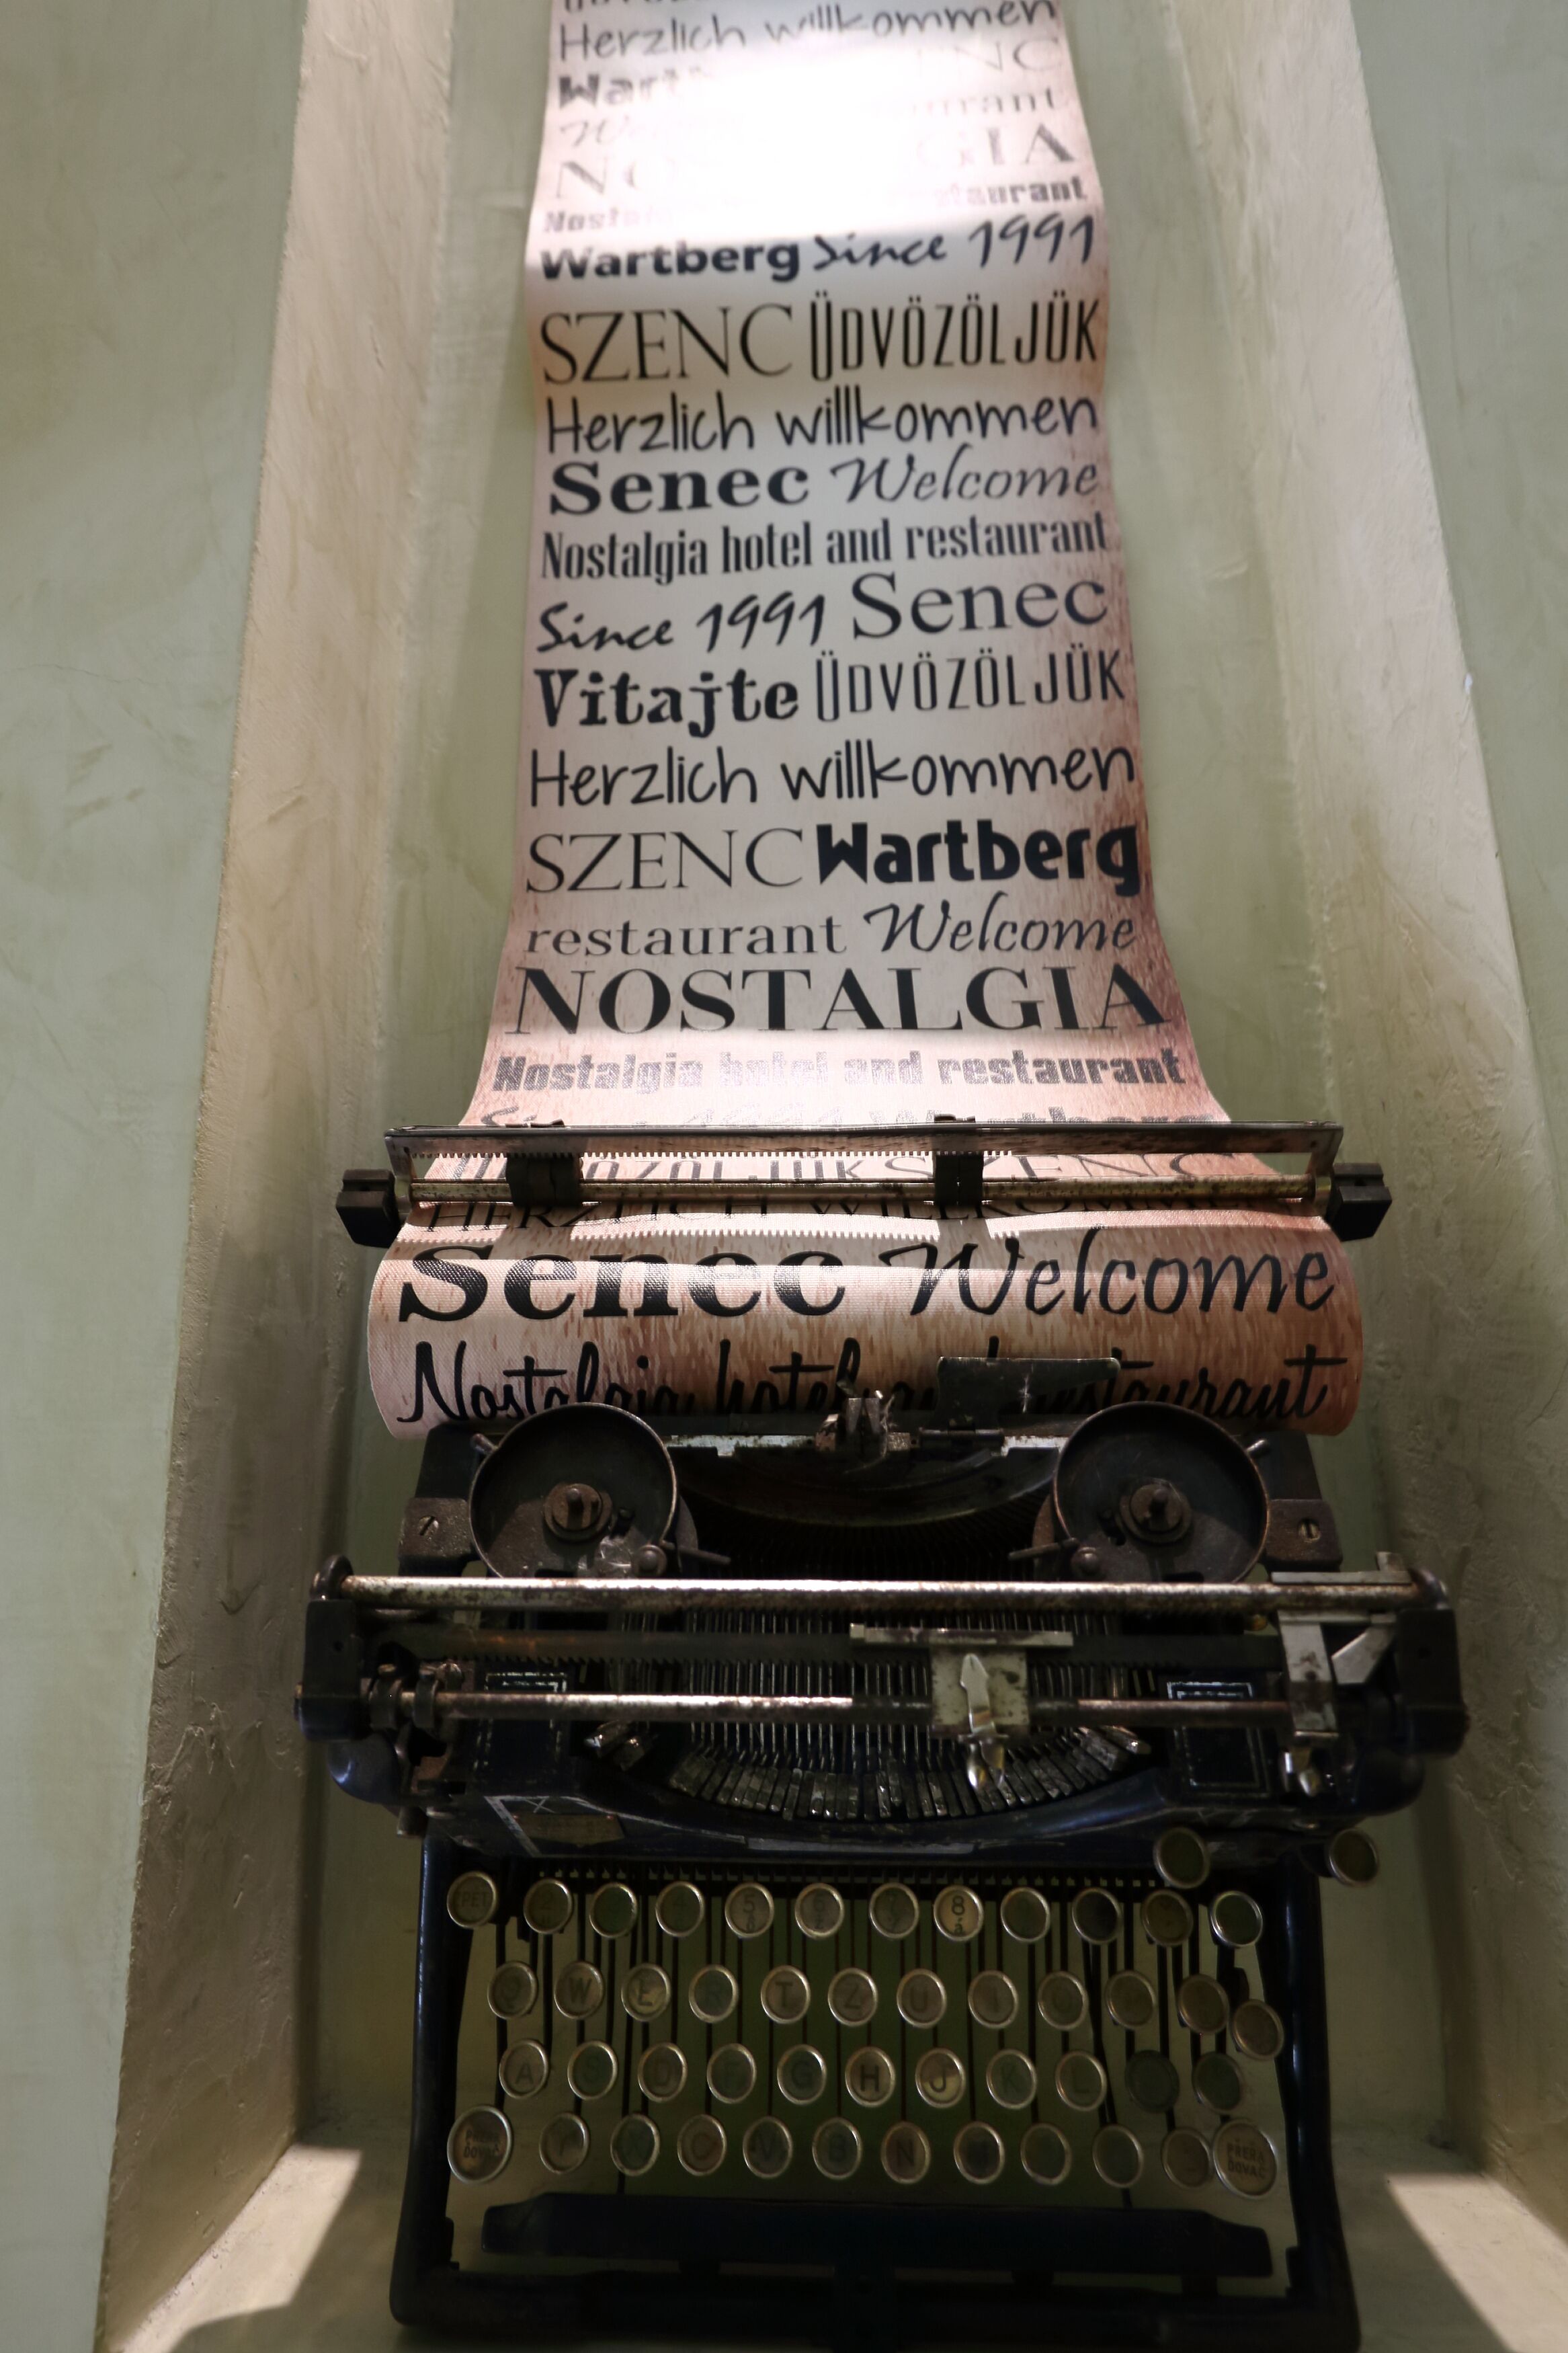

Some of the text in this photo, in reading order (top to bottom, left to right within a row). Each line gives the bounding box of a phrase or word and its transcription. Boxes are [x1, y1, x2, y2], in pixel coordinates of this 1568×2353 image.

[560, 0, 1057, 61] Herzlich willkommen
[540, 211, 1095, 282] Wartberg Since 1991
[540, 290, 1100, 385] SZENC ÜDVÖZÖLJÜK
[547, 385, 1098, 454] Herzlich willkommen
[549, 442, 1099, 515] Senec Welcome
[541, 511, 1108, 586] Nostalgia hotel and restaurant
[536, 572, 1108, 652] Since 1991 Senec
[535, 645, 1126, 738] Vitajte ÜDVÖZÖLJÜK
[530, 738, 1135, 807] Herzlich willkommen
[526, 820, 1141, 898] SZENC Wartberg
[526, 891, 1135, 956] restaurant Welcome
[505, 962, 1171, 1035] NOSTALGIA
[492, 1047, 1186, 1095] Nostalgia hotel and restaurant
[397, 1226, 1336, 1322] Senec Welcome
[743, 1894, 755, 1913] 5
[952, 1895, 964, 1916] 8
[569, 1978, 592, 2003] W
[776, 1981, 792, 2007] T
[515, 2062, 534, 2085] A
[860, 2064, 879, 2091] H
[928, 2064, 946, 2091] J
[1072, 2066, 1090, 2093] L
[896, 2139, 914, 2166] N
